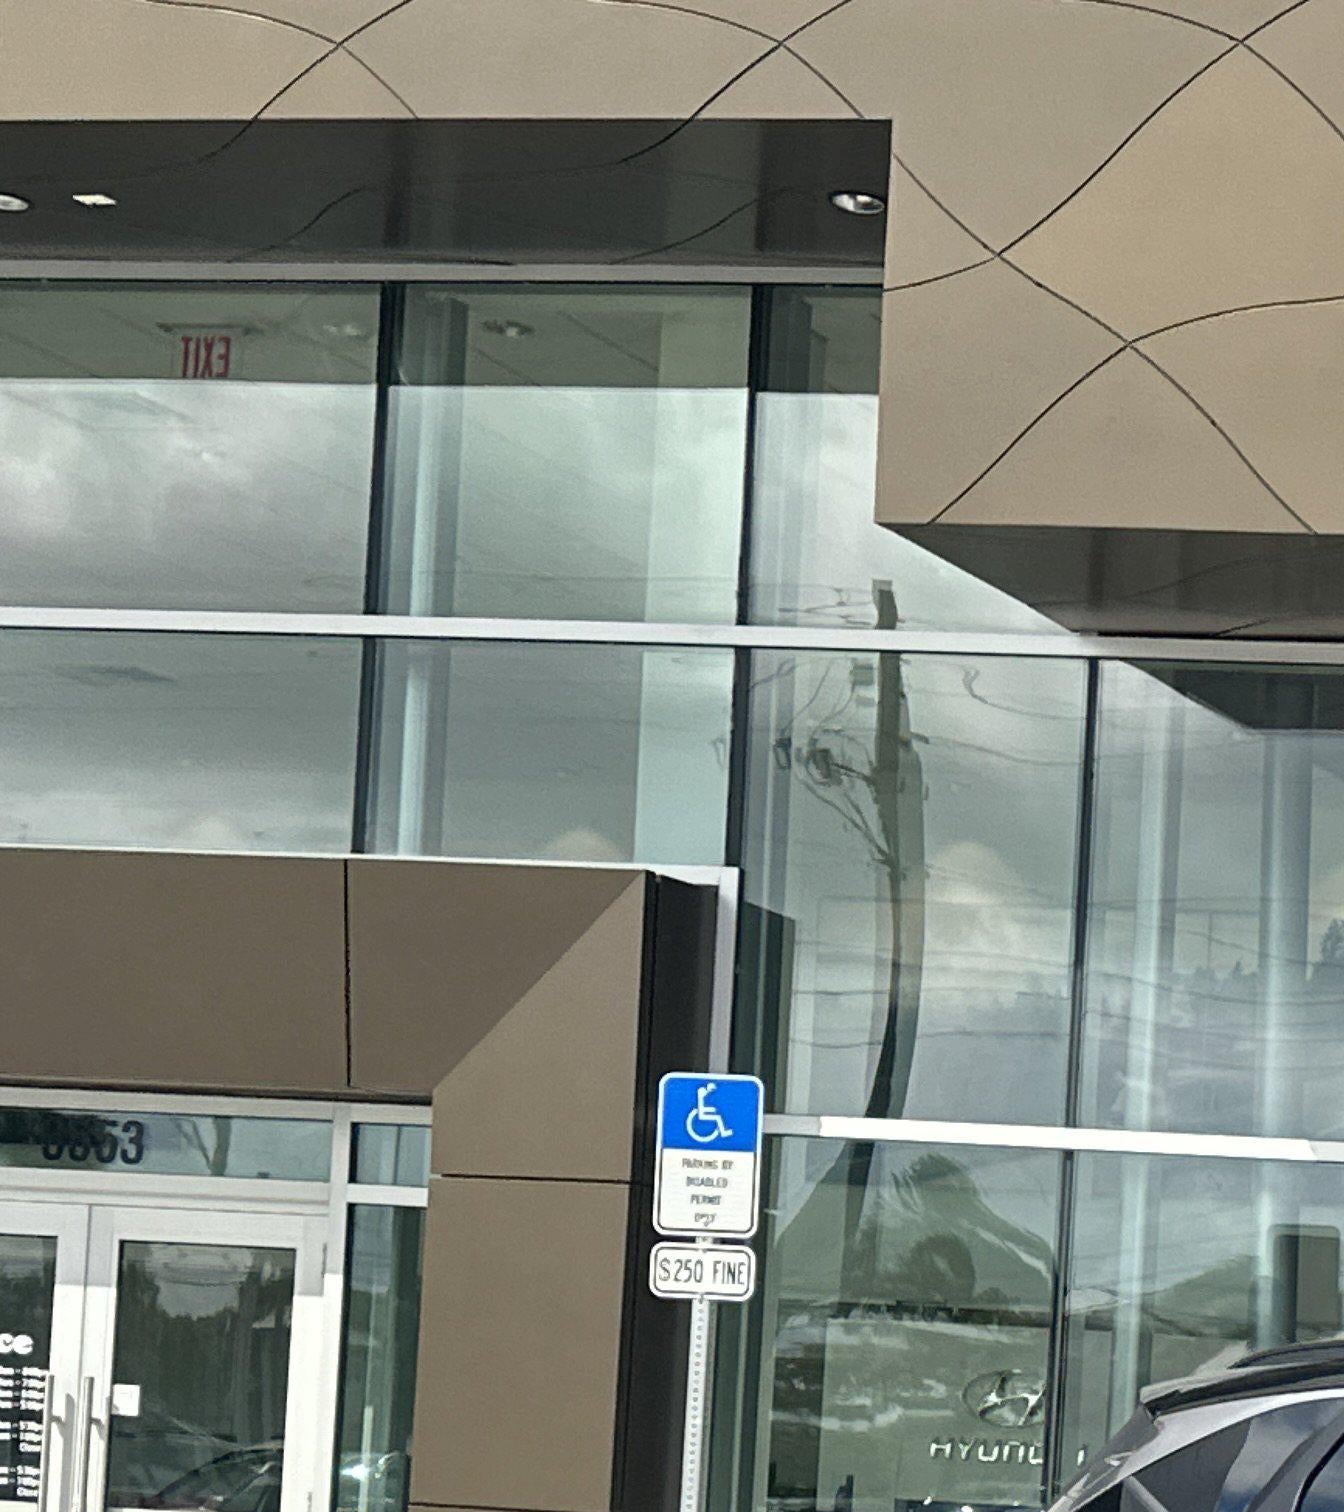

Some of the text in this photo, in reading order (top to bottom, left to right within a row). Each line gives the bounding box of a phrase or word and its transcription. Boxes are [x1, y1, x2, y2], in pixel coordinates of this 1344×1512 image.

[658, 1257, 746, 1286] $250 FINE
[929, 1438, 1086, 1467] HYUNDI
